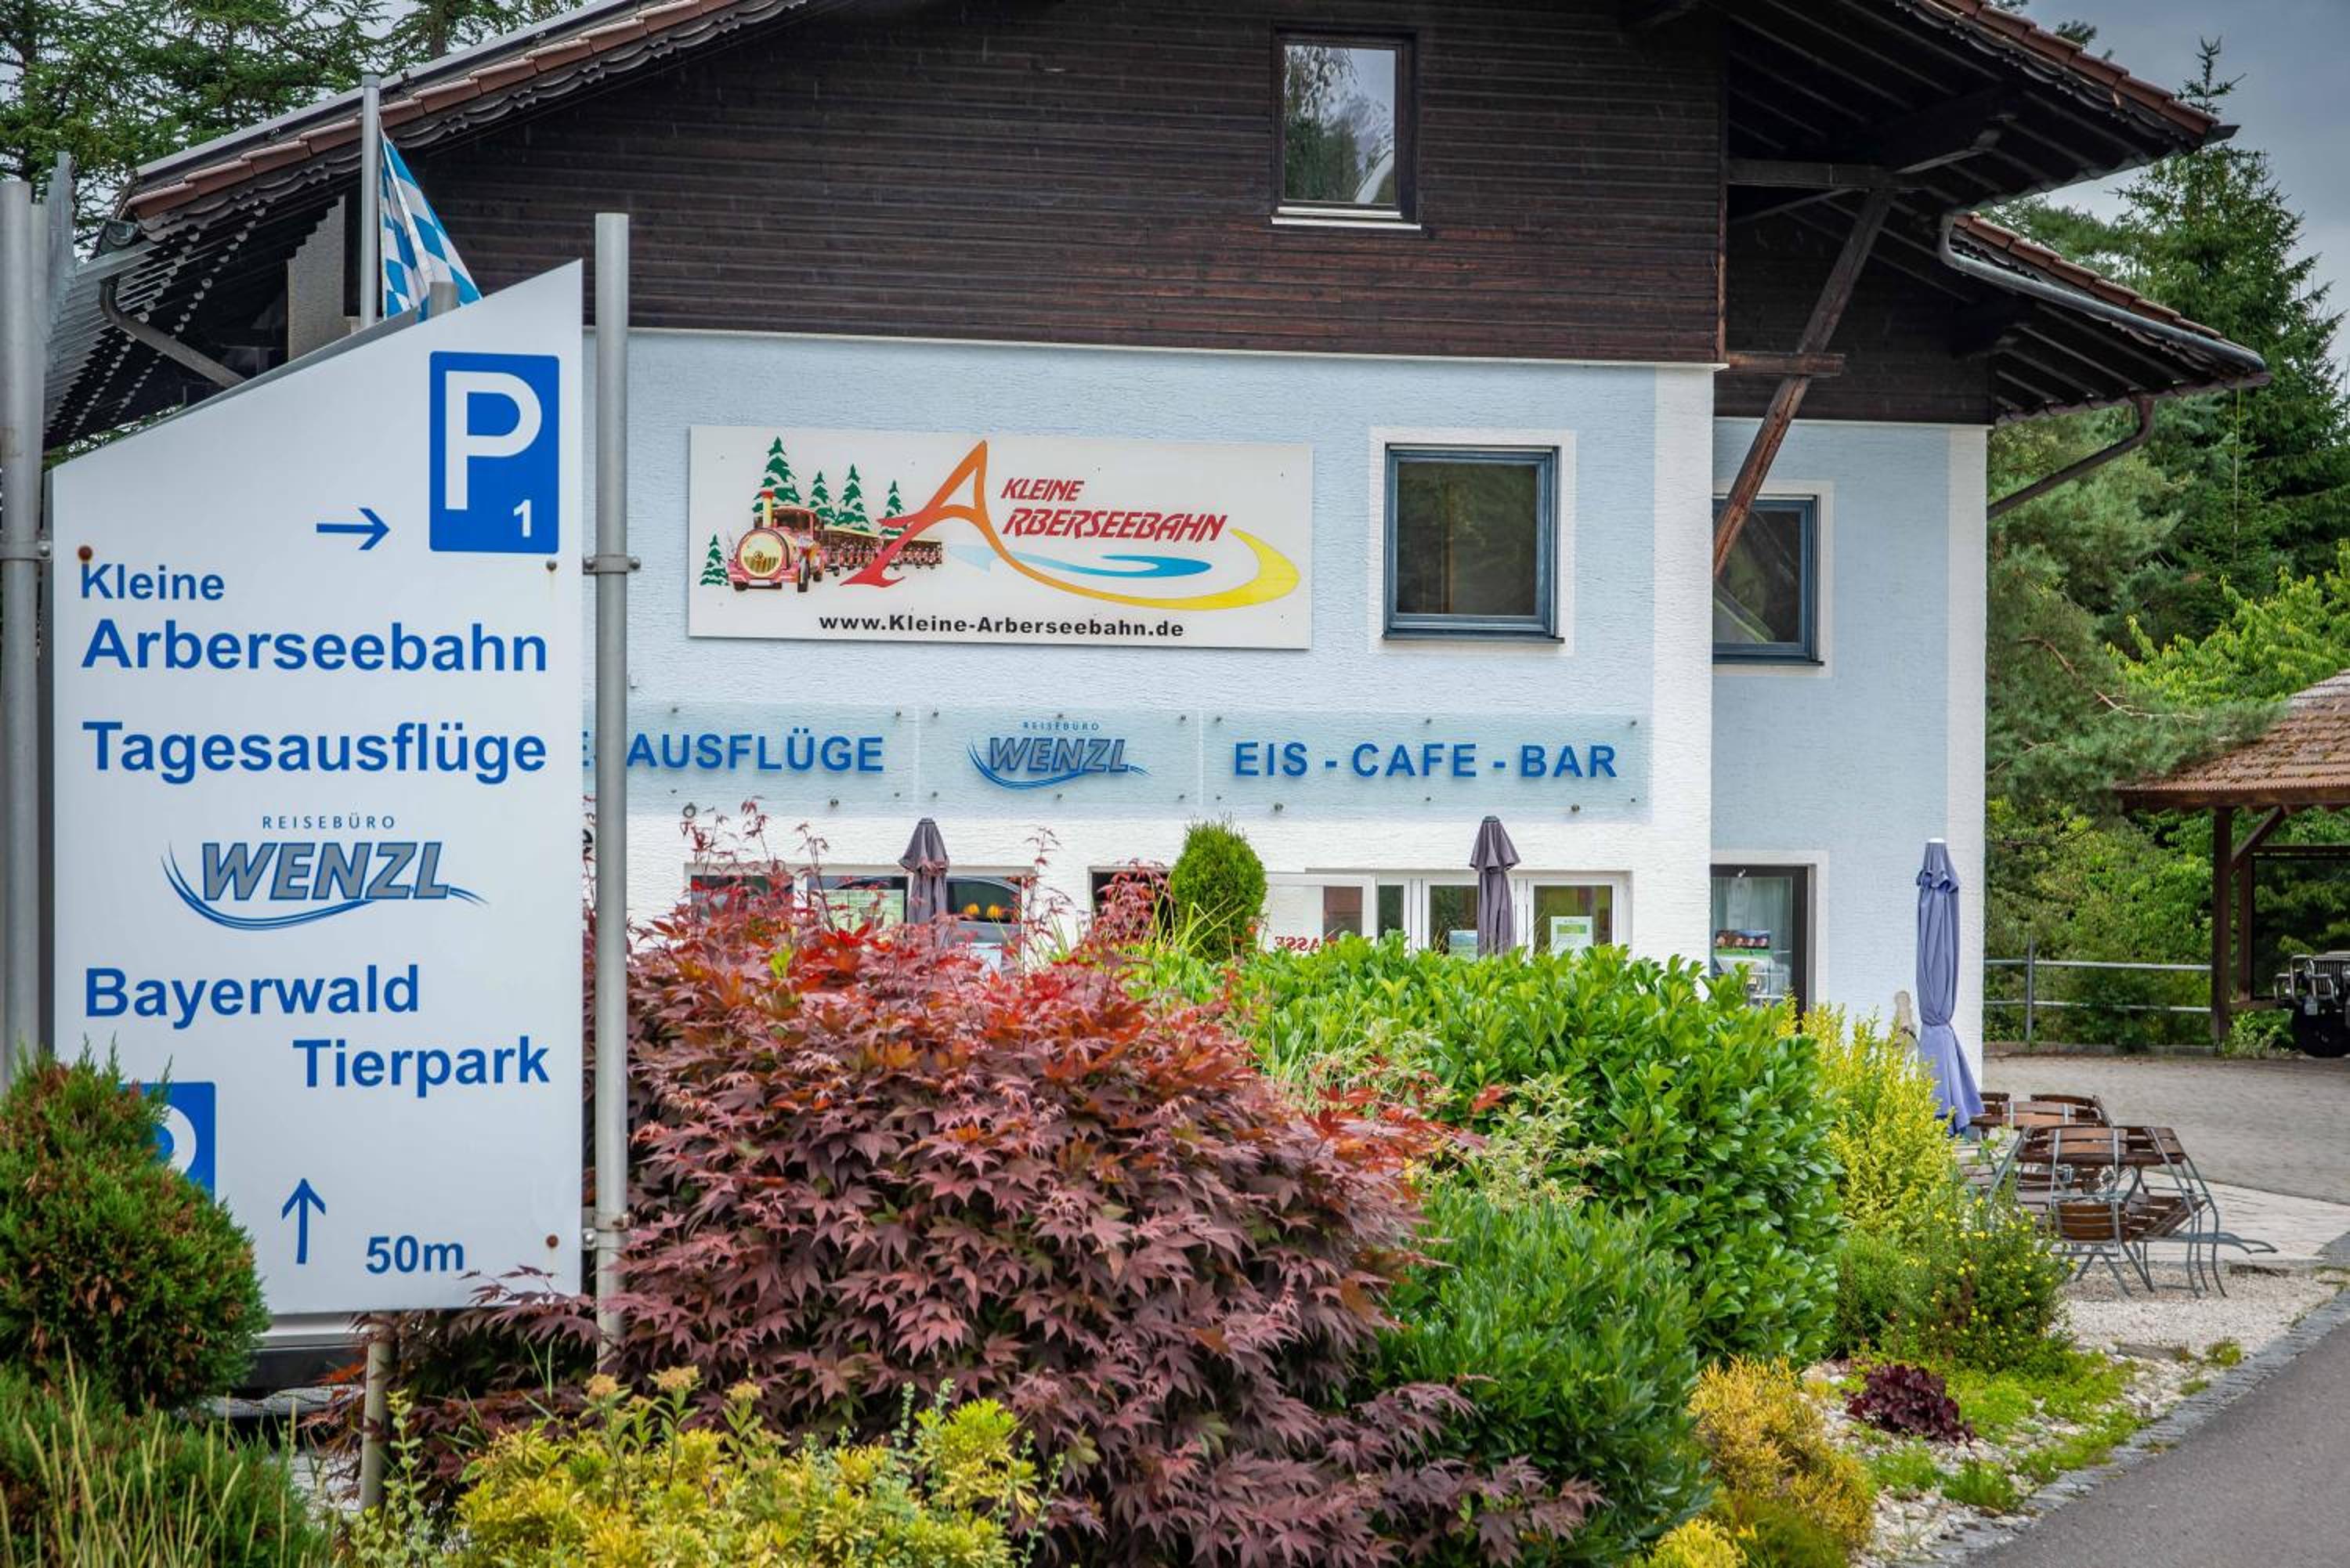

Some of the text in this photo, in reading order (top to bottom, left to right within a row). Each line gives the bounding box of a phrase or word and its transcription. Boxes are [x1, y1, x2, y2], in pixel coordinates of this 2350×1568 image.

[445, 370, 542, 511] P
[1001, 478, 1084, 502] KLEINE
[513, 500, 532, 538] 1
[81, 563, 226, 601] Kleine
[81, 619, 547, 671] Arberseebahn
[819, 614, 1184, 638] www.Kleine-Arberseebahn.de
[82, 721, 547, 785] Tagesausflüge
[583, 728, 884, 772] AUSFLÜGE
[989, 737, 1129, 772] WENZL
[1234, 742, 1308, 778] EIS
[1352, 743, 1477, 779] CAFE
[1520, 745, 1618, 779] BAR
[262, 813, 395, 829] REISEBÜRO
[201, 842, 450, 901] WENZL
[85, 964, 419, 1029] Bayerwald
[292, 1035, 550, 1098] Tierpark
[366, 1235, 465, 1274] 50m
